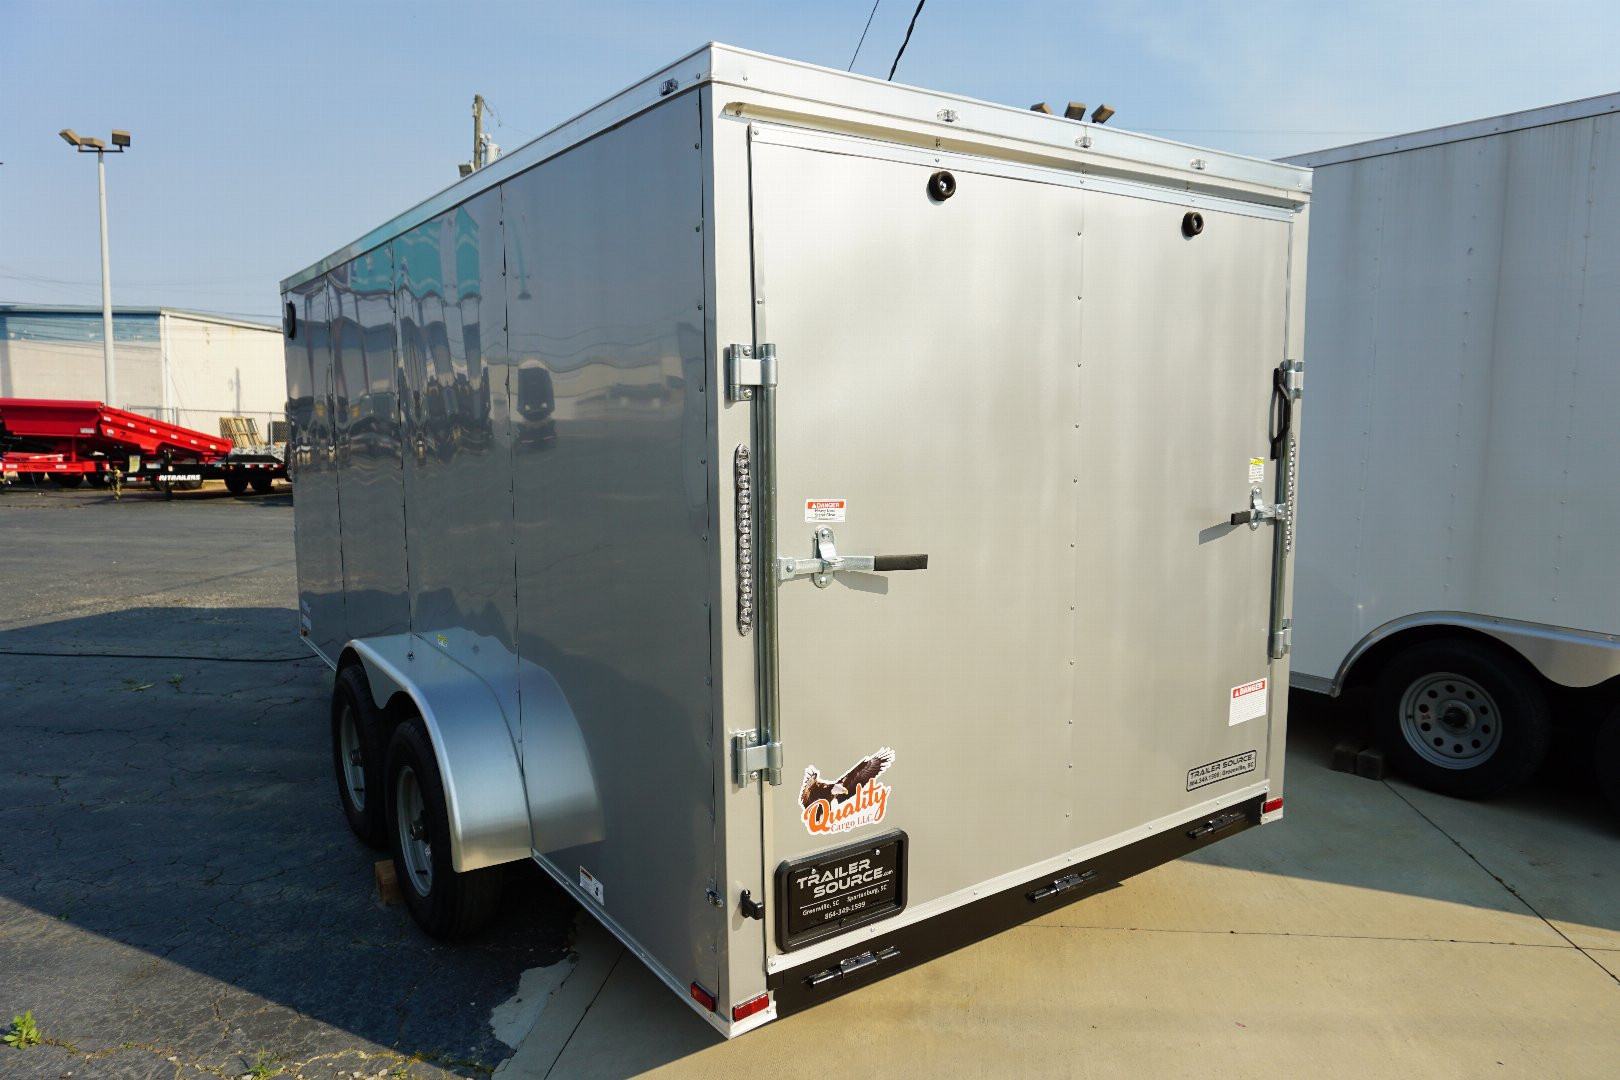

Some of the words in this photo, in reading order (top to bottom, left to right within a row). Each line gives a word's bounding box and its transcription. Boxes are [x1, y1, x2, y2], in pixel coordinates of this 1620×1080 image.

[1240, 683, 1262, 695] DANGER
[1190, 764, 1221, 779] TRAILER
[804, 778, 887, 832] Quality
[831, 820, 855, 832] Cargo
[797, 859, 871, 889] TRAILER
[802, 902, 832, 916] Greenville,
[846, 887, 880, 903] Spartanburg,
